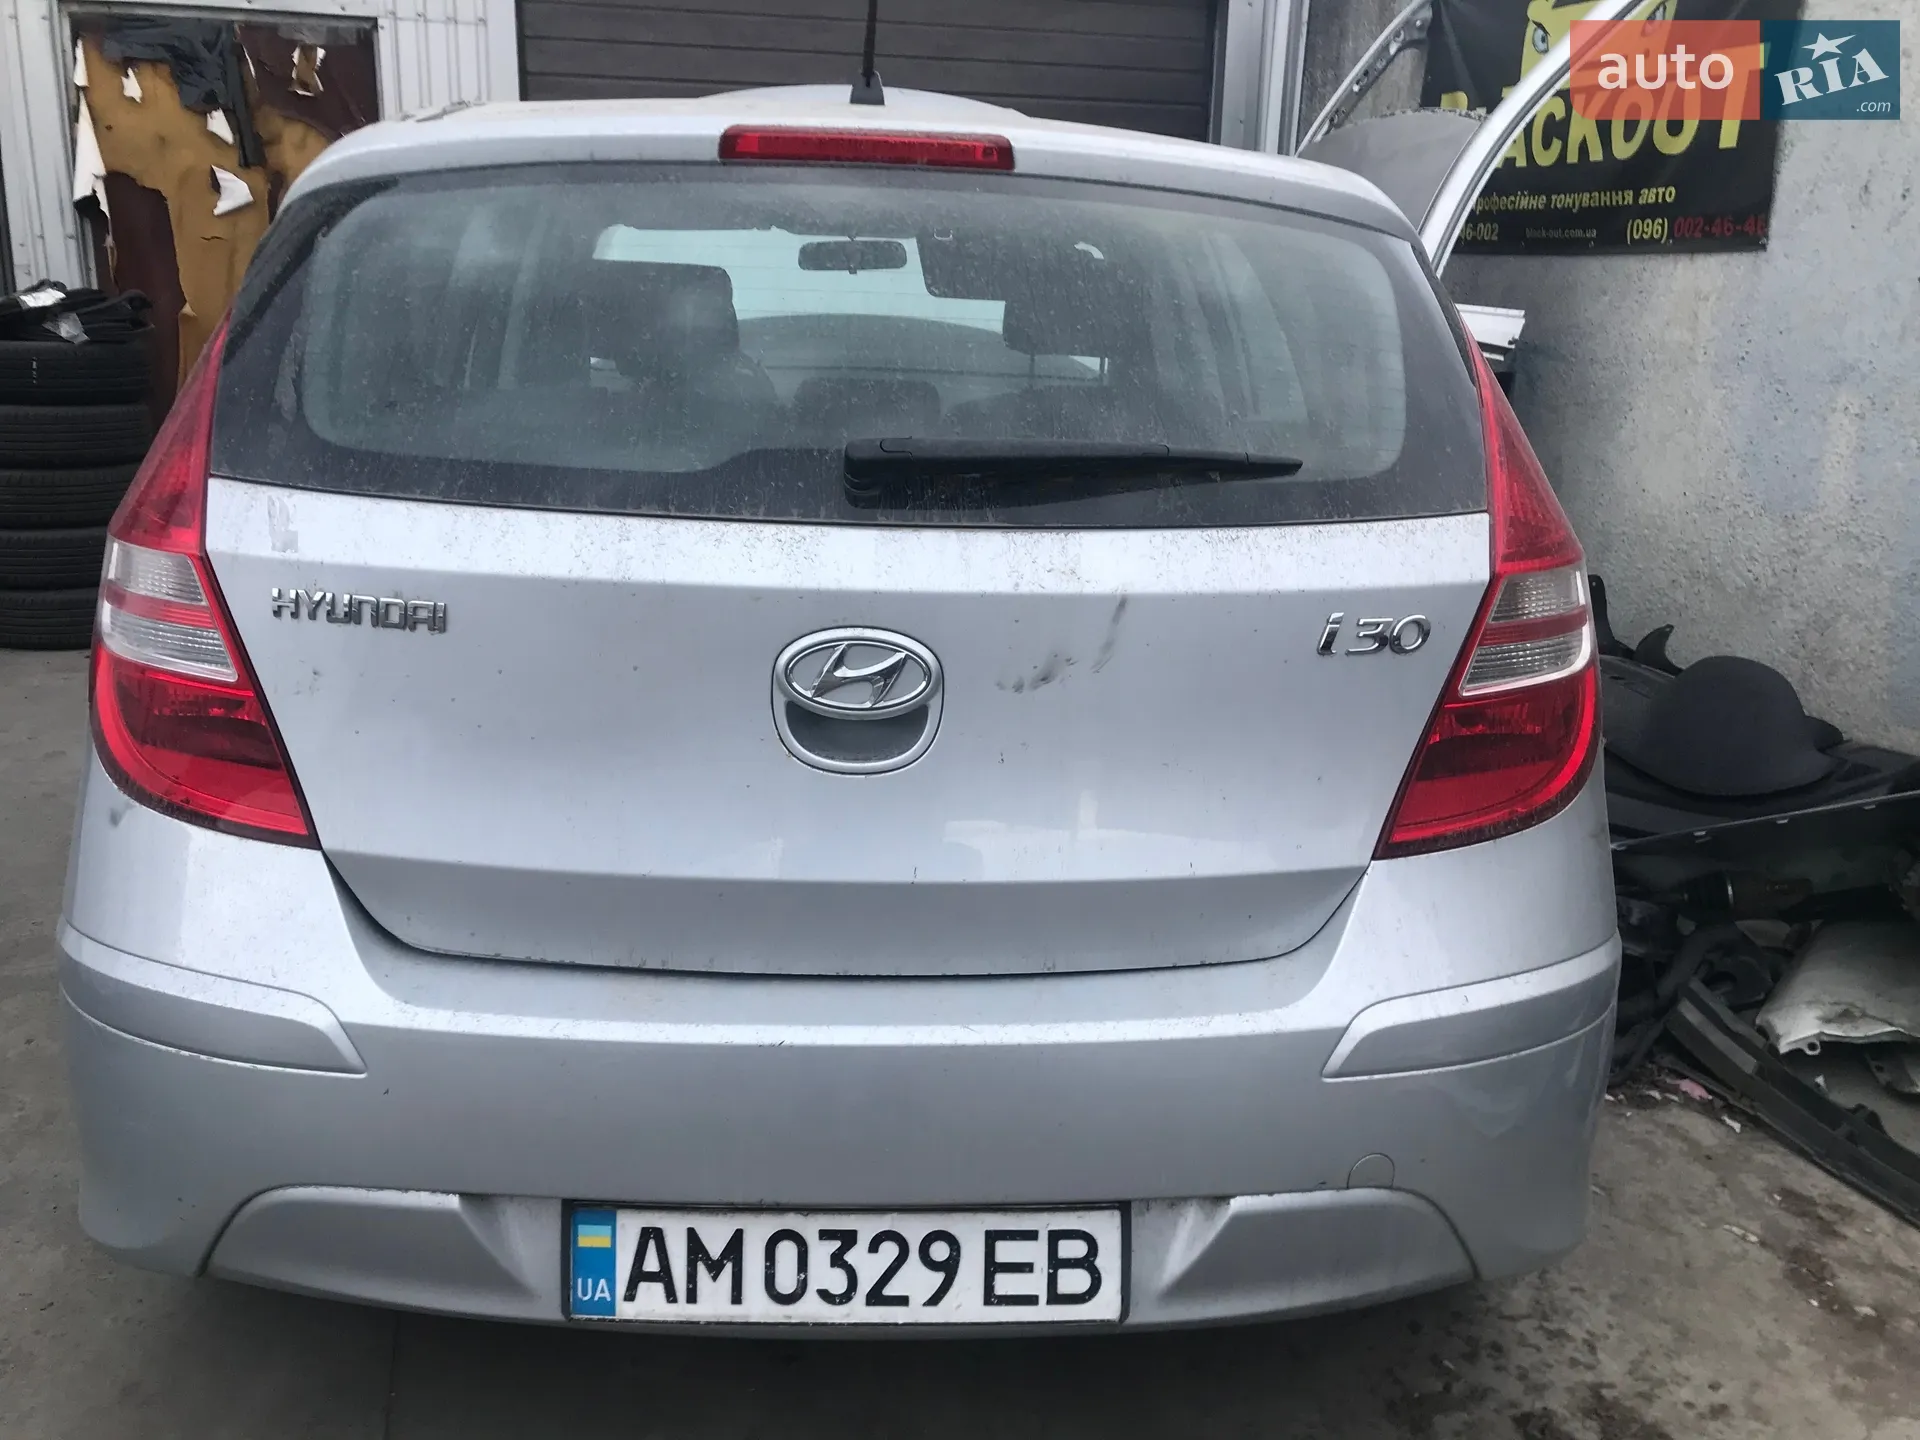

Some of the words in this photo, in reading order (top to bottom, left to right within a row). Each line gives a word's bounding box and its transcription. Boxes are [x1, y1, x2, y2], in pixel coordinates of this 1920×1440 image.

[1472, 190, 1547, 215] рофесійне
[1551, 189, 1634, 214] тонування
[1638, 186, 1677, 205] авто
[1627, 217, 1669, 245] (096)
[271, 587, 447, 635] HYUNDAI
[623, 1226, 744, 1306] AM
[763, 1228, 962, 1308] 0329
[983, 1228, 1104, 1307] EB
[577, 1277, 612, 1302] UA
